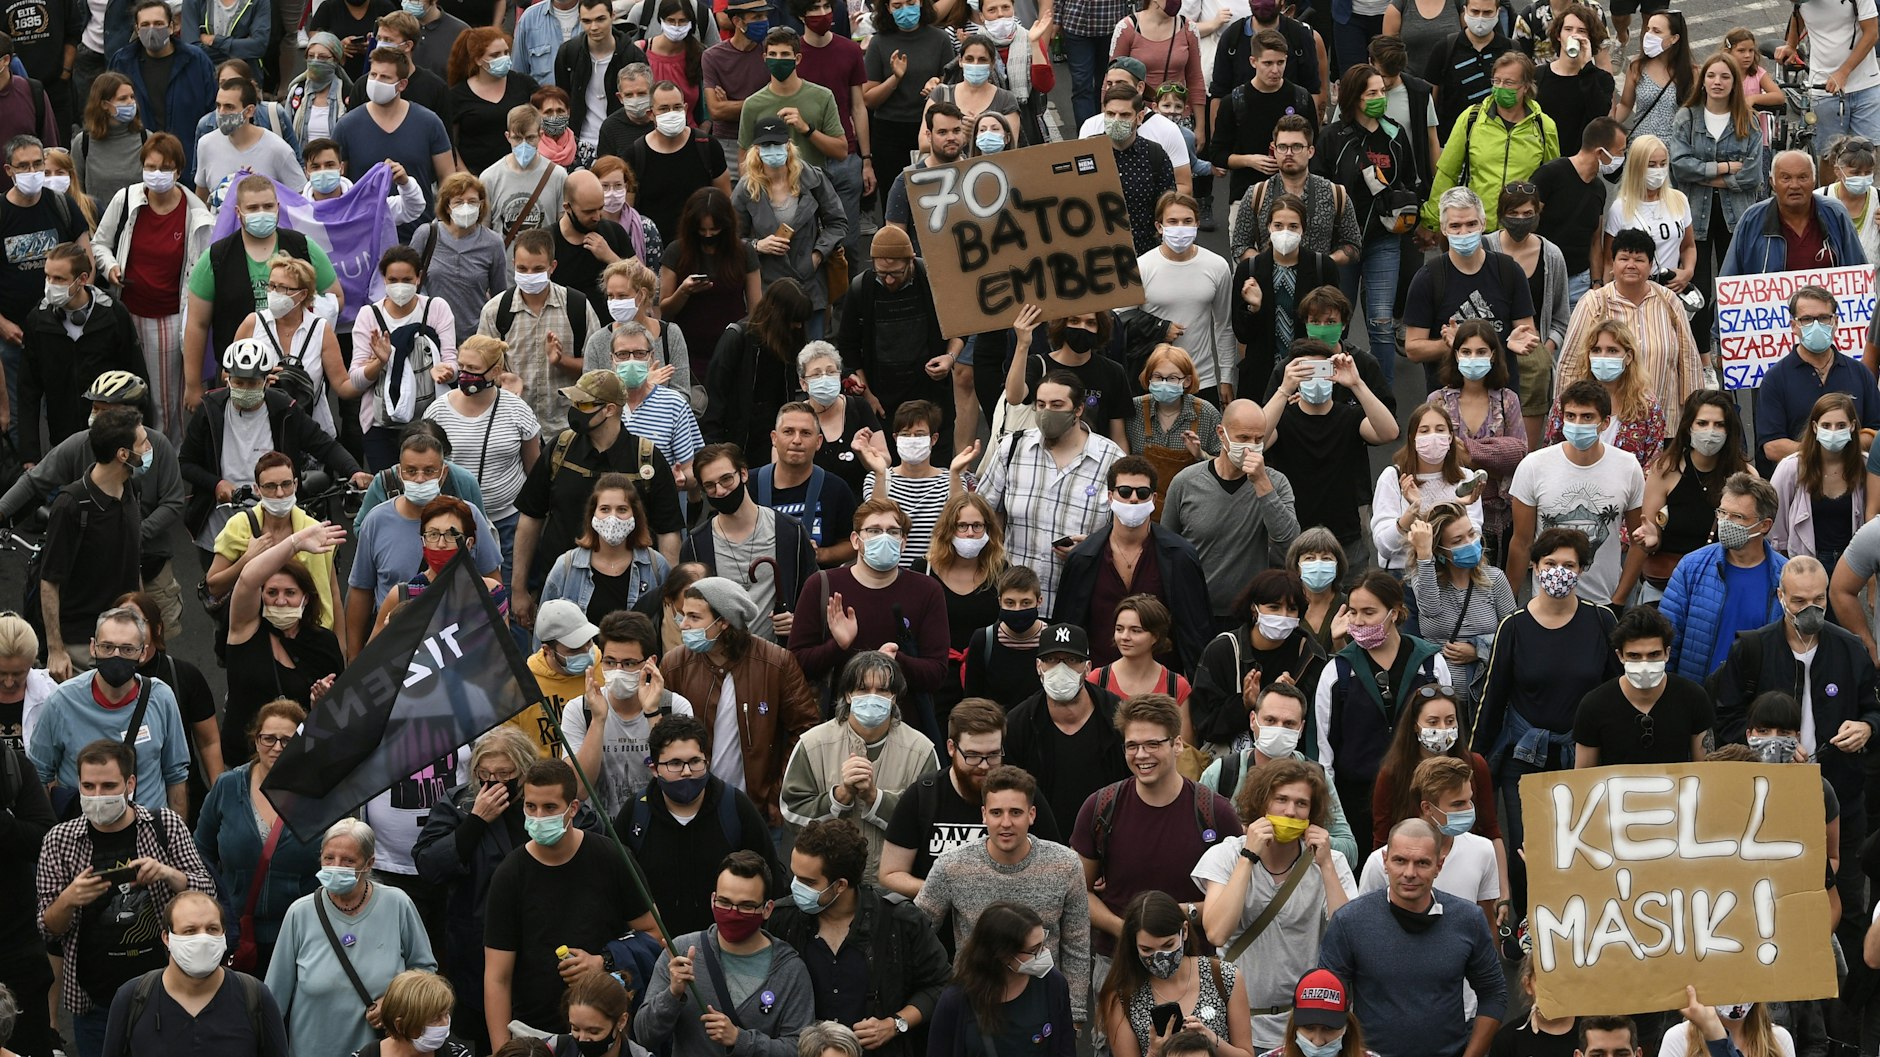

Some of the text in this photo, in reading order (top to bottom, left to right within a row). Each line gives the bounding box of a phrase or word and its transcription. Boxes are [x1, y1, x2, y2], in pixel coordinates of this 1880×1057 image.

[15, 15, 42, 30] 1635
[17, 6, 36, 18] ELTE
[911, 161, 1008, 233] 70
[976, 244, 1142, 315] EMBER
[1055, 627, 1071, 643] NY
[1552, 776, 1804, 870] KELL
[1536, 868, 1778, 973] MÁSIK!
[1301, 988, 1341, 1002] ARIZONA
